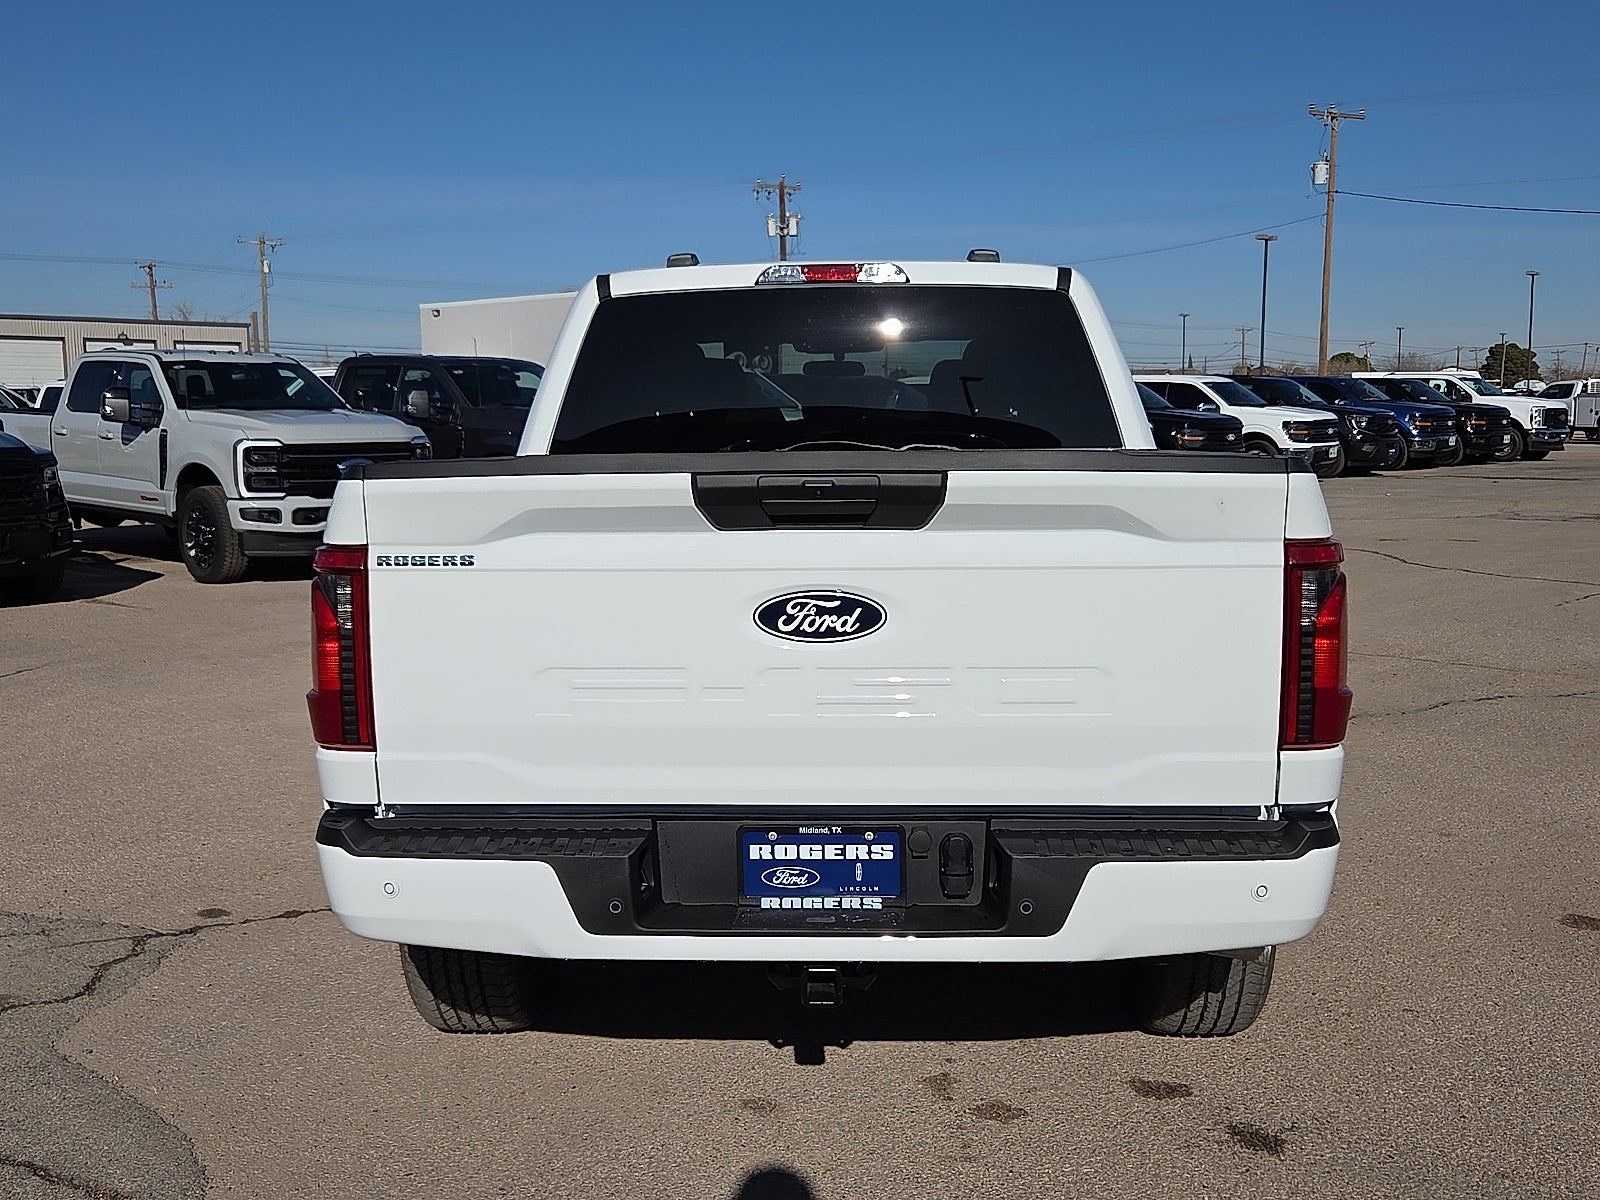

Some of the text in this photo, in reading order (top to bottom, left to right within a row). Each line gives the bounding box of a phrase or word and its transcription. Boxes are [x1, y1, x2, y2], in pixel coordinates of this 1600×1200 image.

[376, 555, 475, 567] ROGERS
[777, 598, 862, 632] Ford
[799, 826, 842, 835] Midland, TX
[749, 844, 894, 860] ROGERS
[772, 869, 809, 885] Ford
[760, 897, 883, 910] ROGERS
